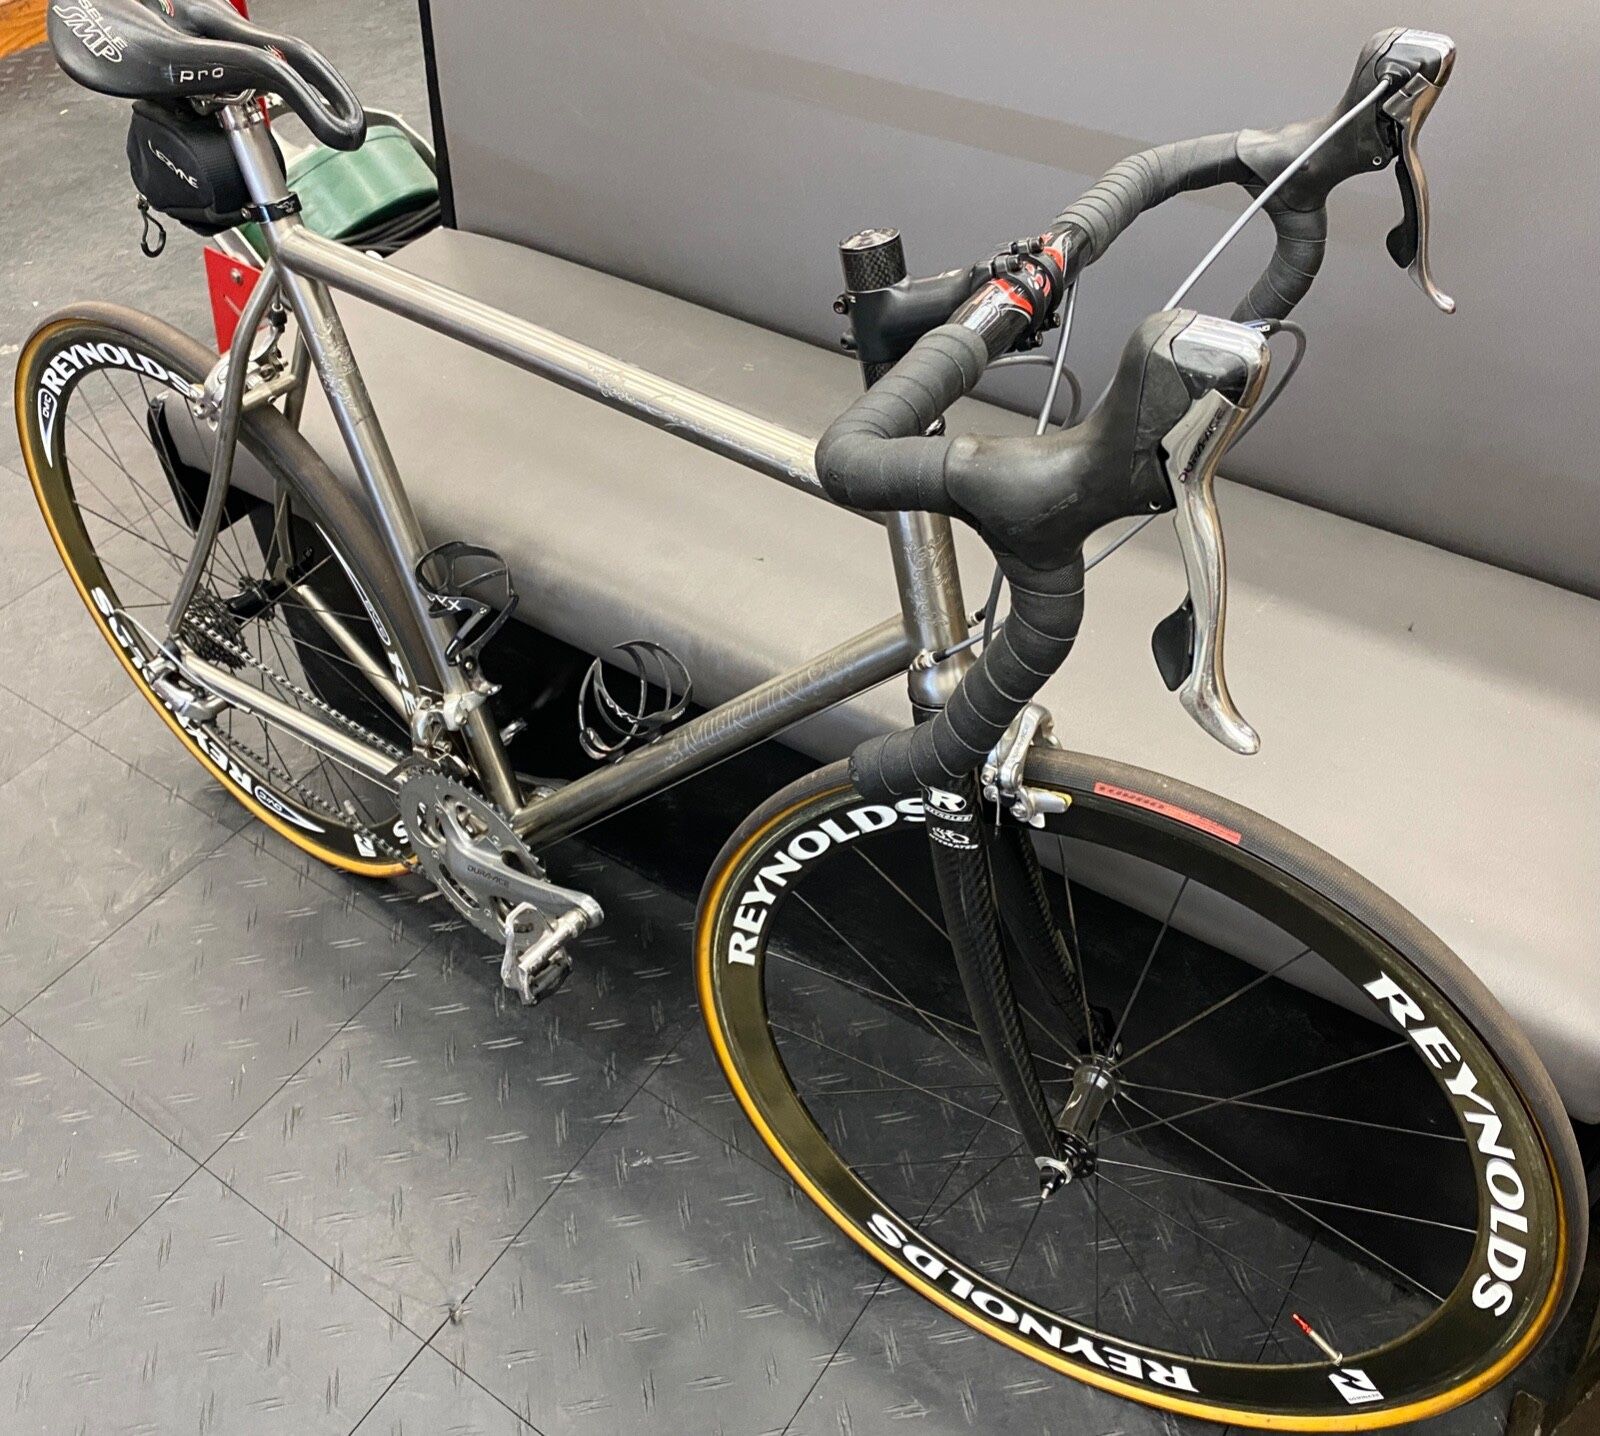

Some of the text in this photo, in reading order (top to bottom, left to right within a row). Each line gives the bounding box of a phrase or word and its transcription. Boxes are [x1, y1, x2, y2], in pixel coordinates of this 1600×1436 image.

[52, 5, 122, 62] SMP
[78, 0, 128, 51] SELLE
[180, 67, 224, 83] pro
[41, 342, 190, 398] REYNOLDS
[728, 797, 926, 966] REYNOLDS
[1363, 971, 1528, 1317] REYNOLDS
[867, 1212, 1199, 1394] REYNOLDS
